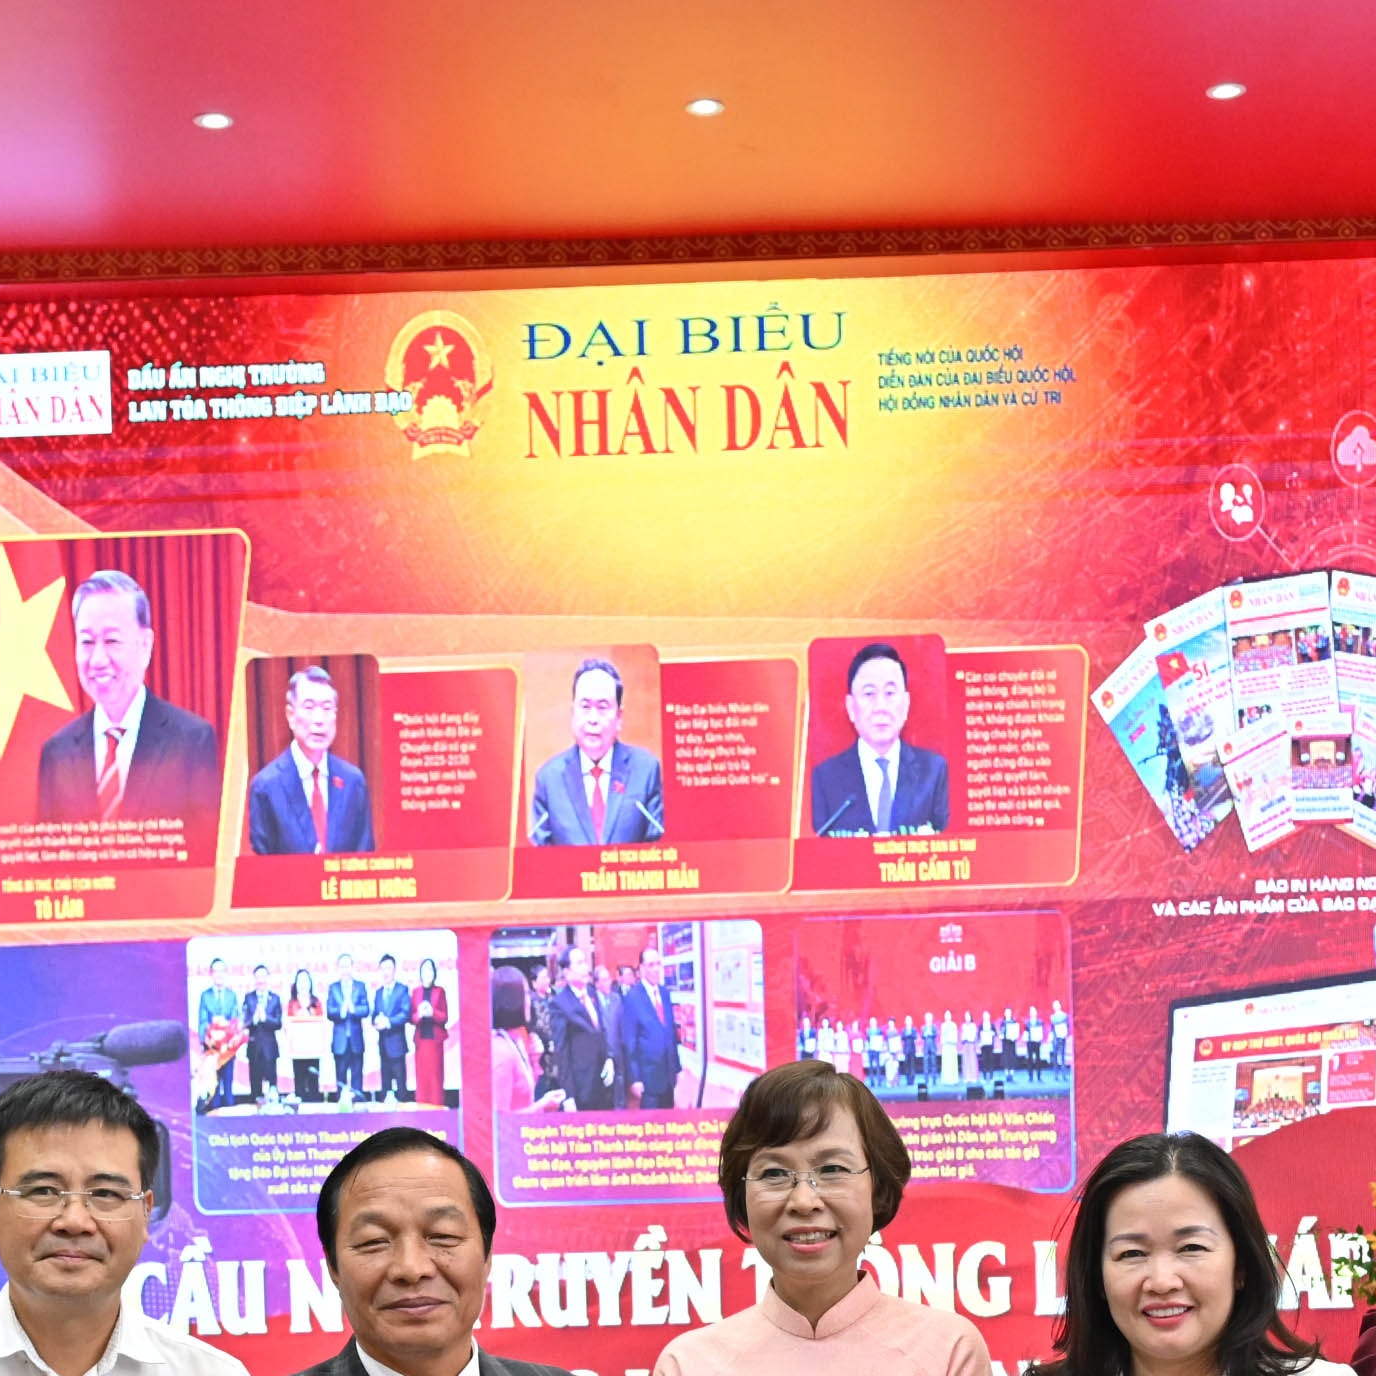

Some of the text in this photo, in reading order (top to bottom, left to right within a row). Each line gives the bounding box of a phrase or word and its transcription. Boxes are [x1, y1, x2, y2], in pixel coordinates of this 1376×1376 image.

[521, 302, 848, 367] ĐẠI BIỂU
[878, 343, 1024, 366] TIẾNG NÓI CỦA QUỐC HỘI
[30, 361, 102, 386] BIỂU
[127, 362, 166, 391] DẤU
[878, 369, 905, 389] DIỄN
[908, 371, 933, 387] ĐÀN
[936, 367, 960, 386] CỦA
[963, 372, 982, 387] ĐẠI
[986, 364, 1013, 385] BIỂU
[1016, 364, 1050, 383] QUỐC
[50, 386, 106, 425] DÂN
[127, 401, 167, 423] LAN
[209, 393, 273, 420] THÔNG
[522, 360, 852, 459] NHÂN DÂN
[878, 394, 898, 413] HỘI
[902, 392, 936, 411] ĐỒNG
[939, 391, 972, 408] NHÂN
[975, 390, 999, 407] DÂN
[1002, 389, 1018, 406] VÀ
[1043, 390, 1062, 405] TRI
[121, 1236, 268, 1335] CẦU
[472, 1224, 723, 1328] RUYỀN
[740, 1231, 1012, 1317] TÔNG
